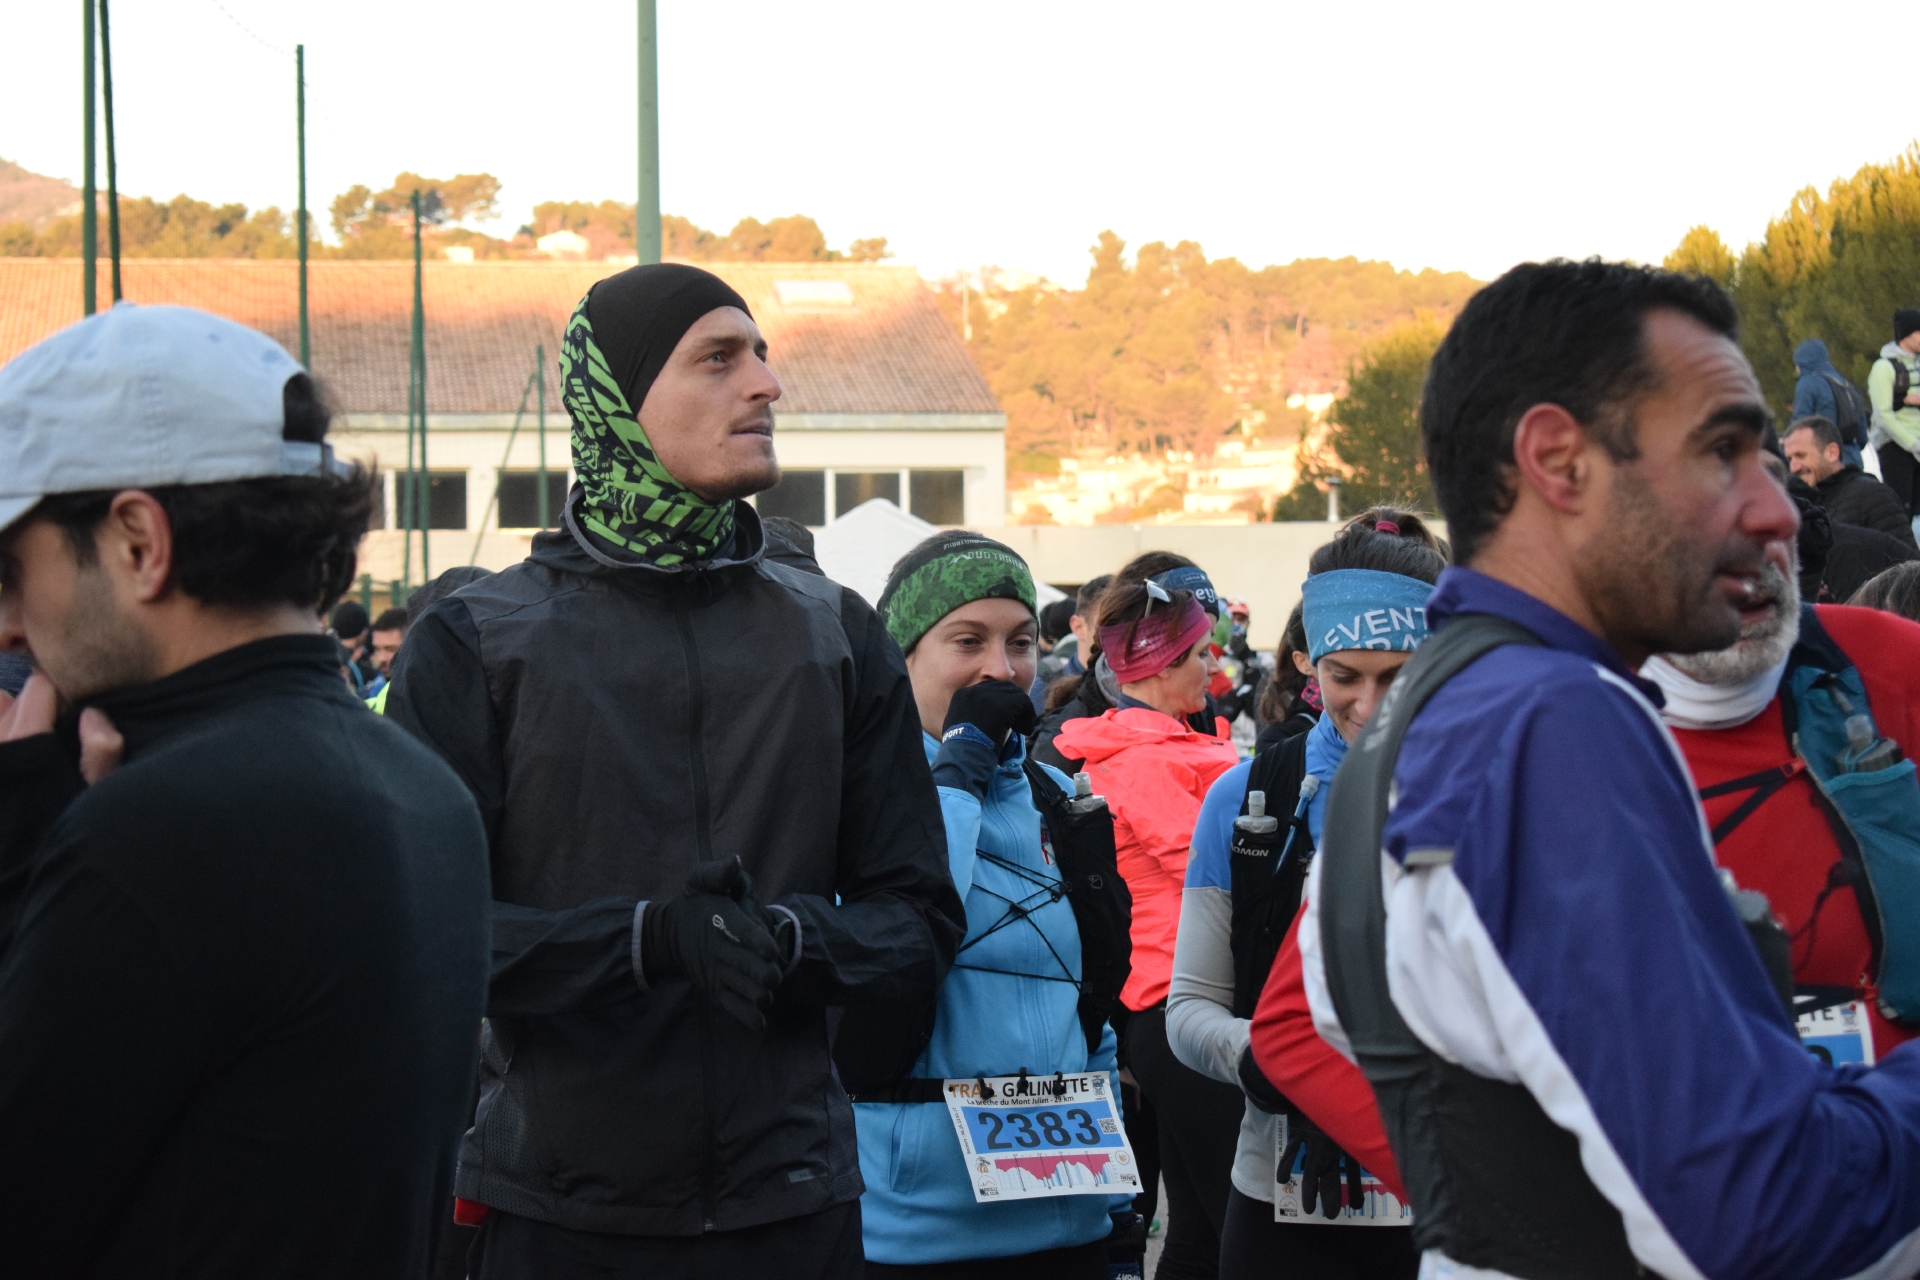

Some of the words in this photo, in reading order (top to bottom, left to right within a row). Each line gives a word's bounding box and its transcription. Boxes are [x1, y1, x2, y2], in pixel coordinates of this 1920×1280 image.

[1000, 1098, 1010, 1106] du
[1032, 1097, 1049, 1105] Julien
[1054, 1095, 1062, 1103] 29
[977, 1108, 1101, 1150] 2383
